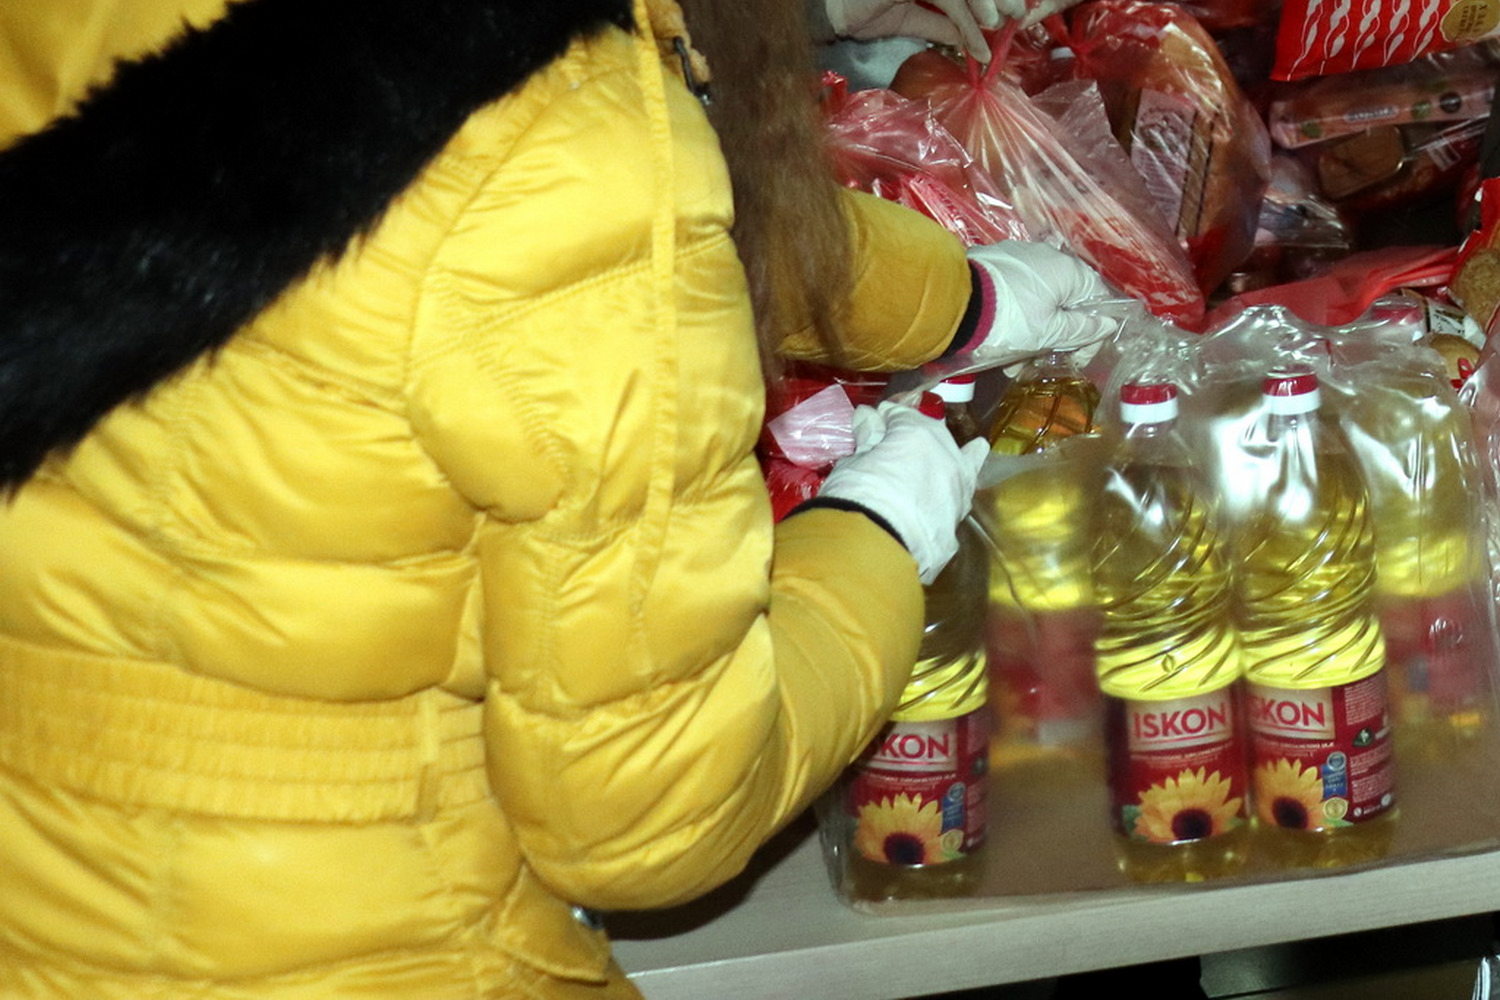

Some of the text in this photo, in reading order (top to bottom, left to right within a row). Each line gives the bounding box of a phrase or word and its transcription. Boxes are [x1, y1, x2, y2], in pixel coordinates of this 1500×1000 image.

[1132, 702, 1228, 739] ISKON
[1252, 698, 1325, 728] KON
[880, 733, 951, 759] KON
